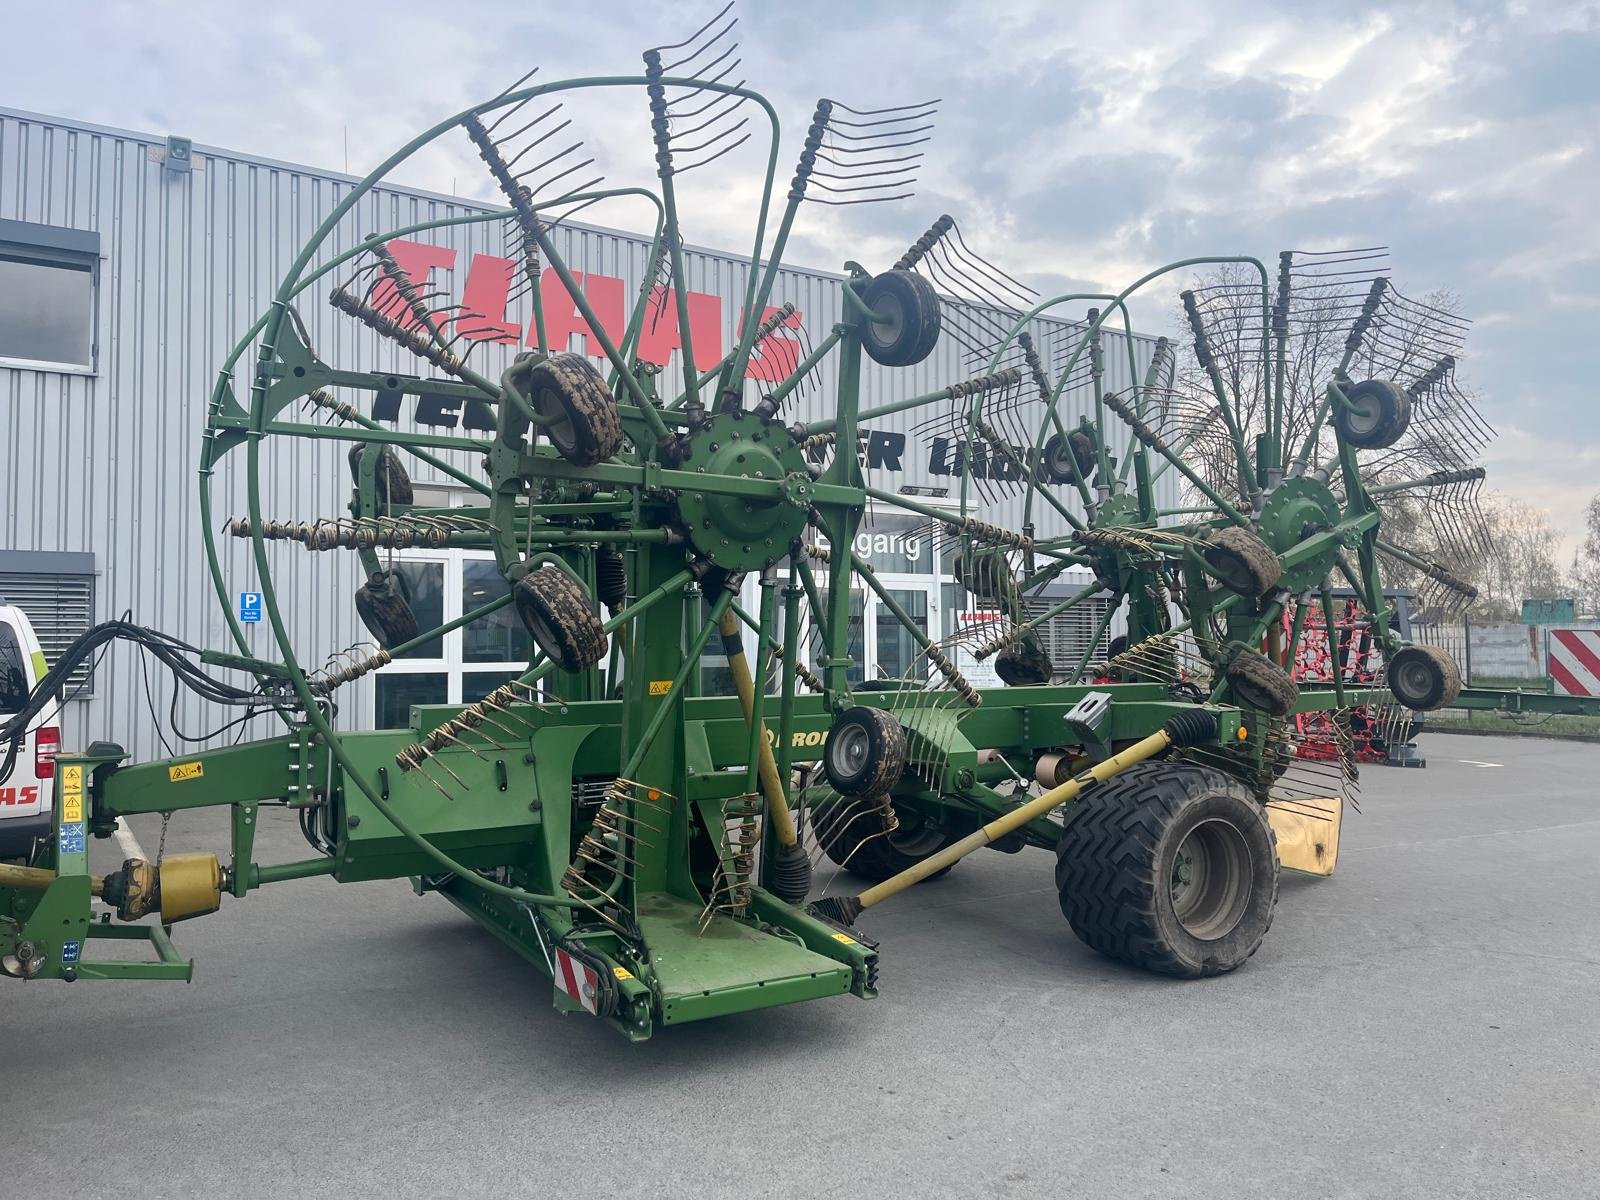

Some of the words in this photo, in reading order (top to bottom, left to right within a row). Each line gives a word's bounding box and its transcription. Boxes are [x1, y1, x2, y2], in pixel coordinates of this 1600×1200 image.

[371, 239, 803, 384] CLAAS
[814, 526, 920, 561] Egang
[245, 594, 257, 609] P
